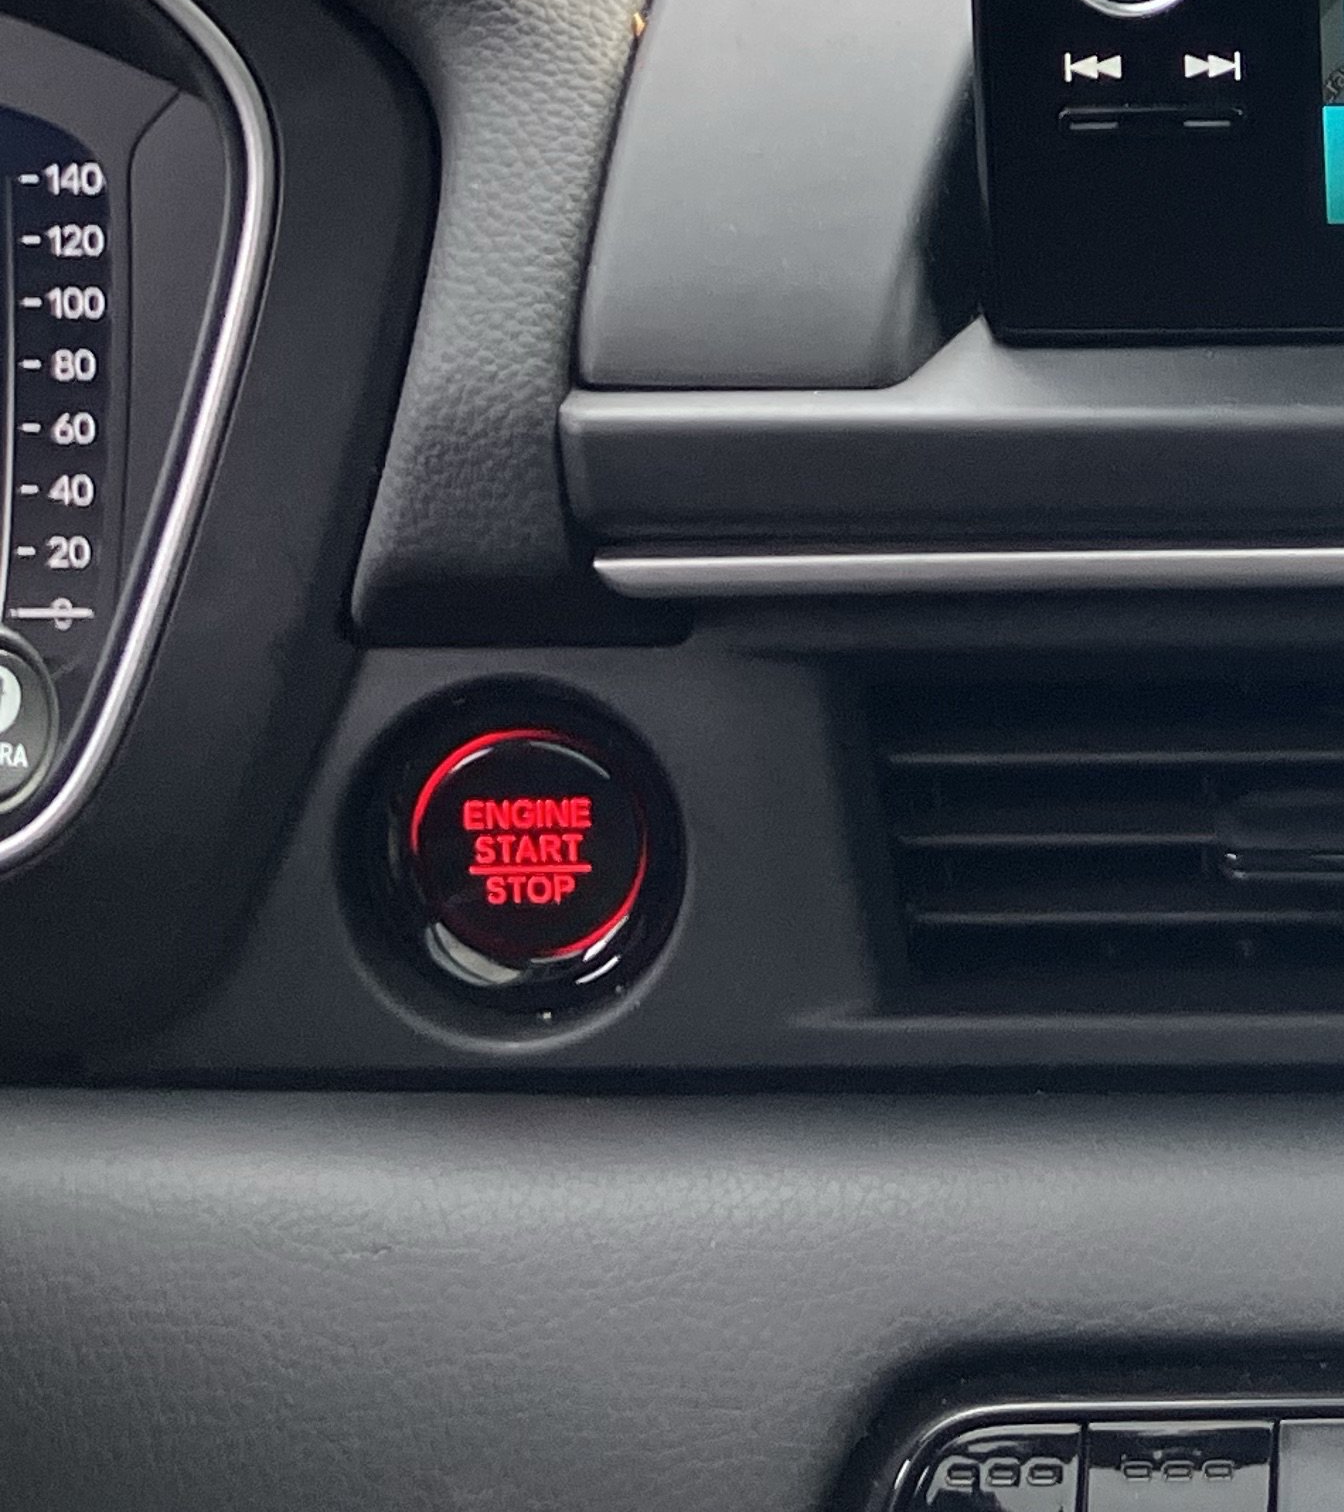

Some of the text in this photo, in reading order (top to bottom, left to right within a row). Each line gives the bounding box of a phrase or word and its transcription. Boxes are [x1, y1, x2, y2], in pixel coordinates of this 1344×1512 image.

[45, 161, 104, 196] 140
[47, 223, 105, 257] 120
[47, 285, 105, 320] 100
[52, 347, 97, 382] 80
[53, 411, 96, 445] 60
[49, 473, 95, 507] 40
[47, 535, 92, 569] 20
[0, 742, 28, 768] RA
[462, 796, 593, 831] ENGINE
[474, 833, 584, 864] START
[485, 875, 576, 905] STOP
